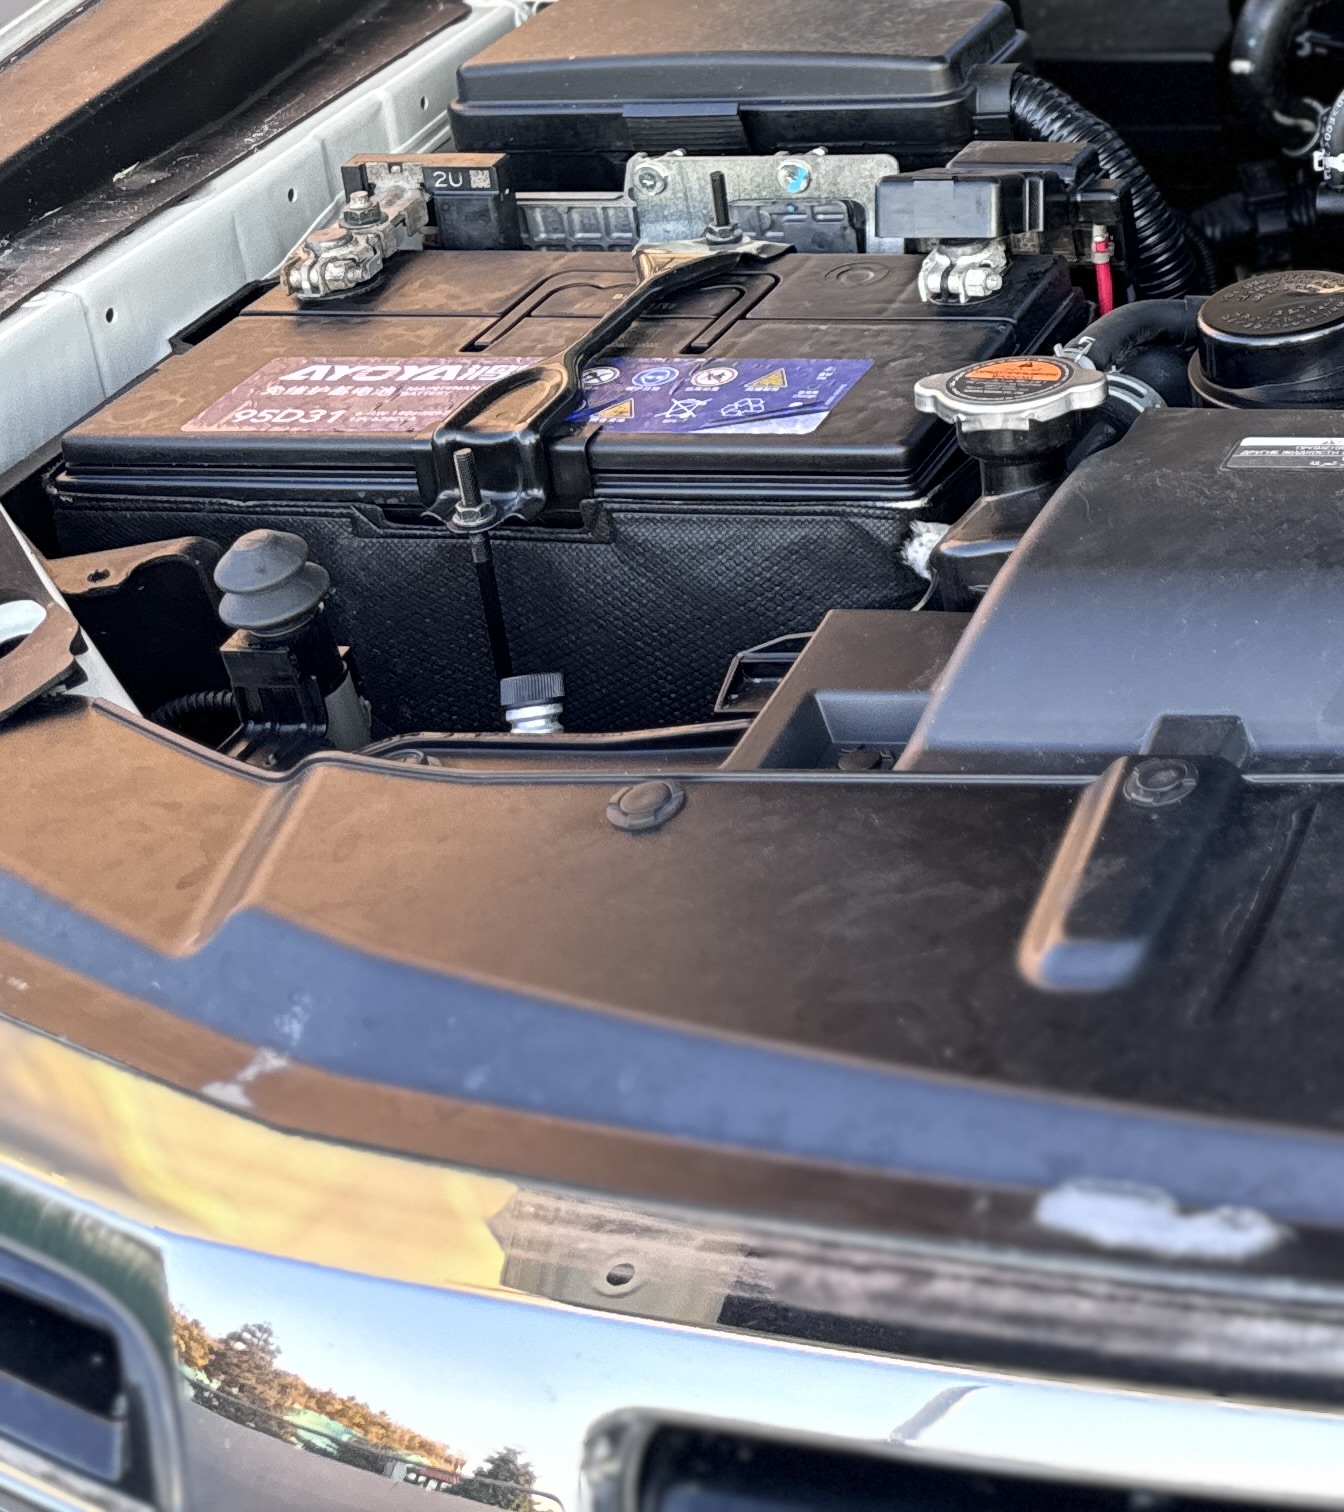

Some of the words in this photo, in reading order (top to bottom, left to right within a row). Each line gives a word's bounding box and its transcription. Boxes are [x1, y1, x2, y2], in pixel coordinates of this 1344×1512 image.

[432, 170, 463, 188] 2U
[278, 364, 463, 381] AYOYA
[231, 408, 347, 423] 95D31
